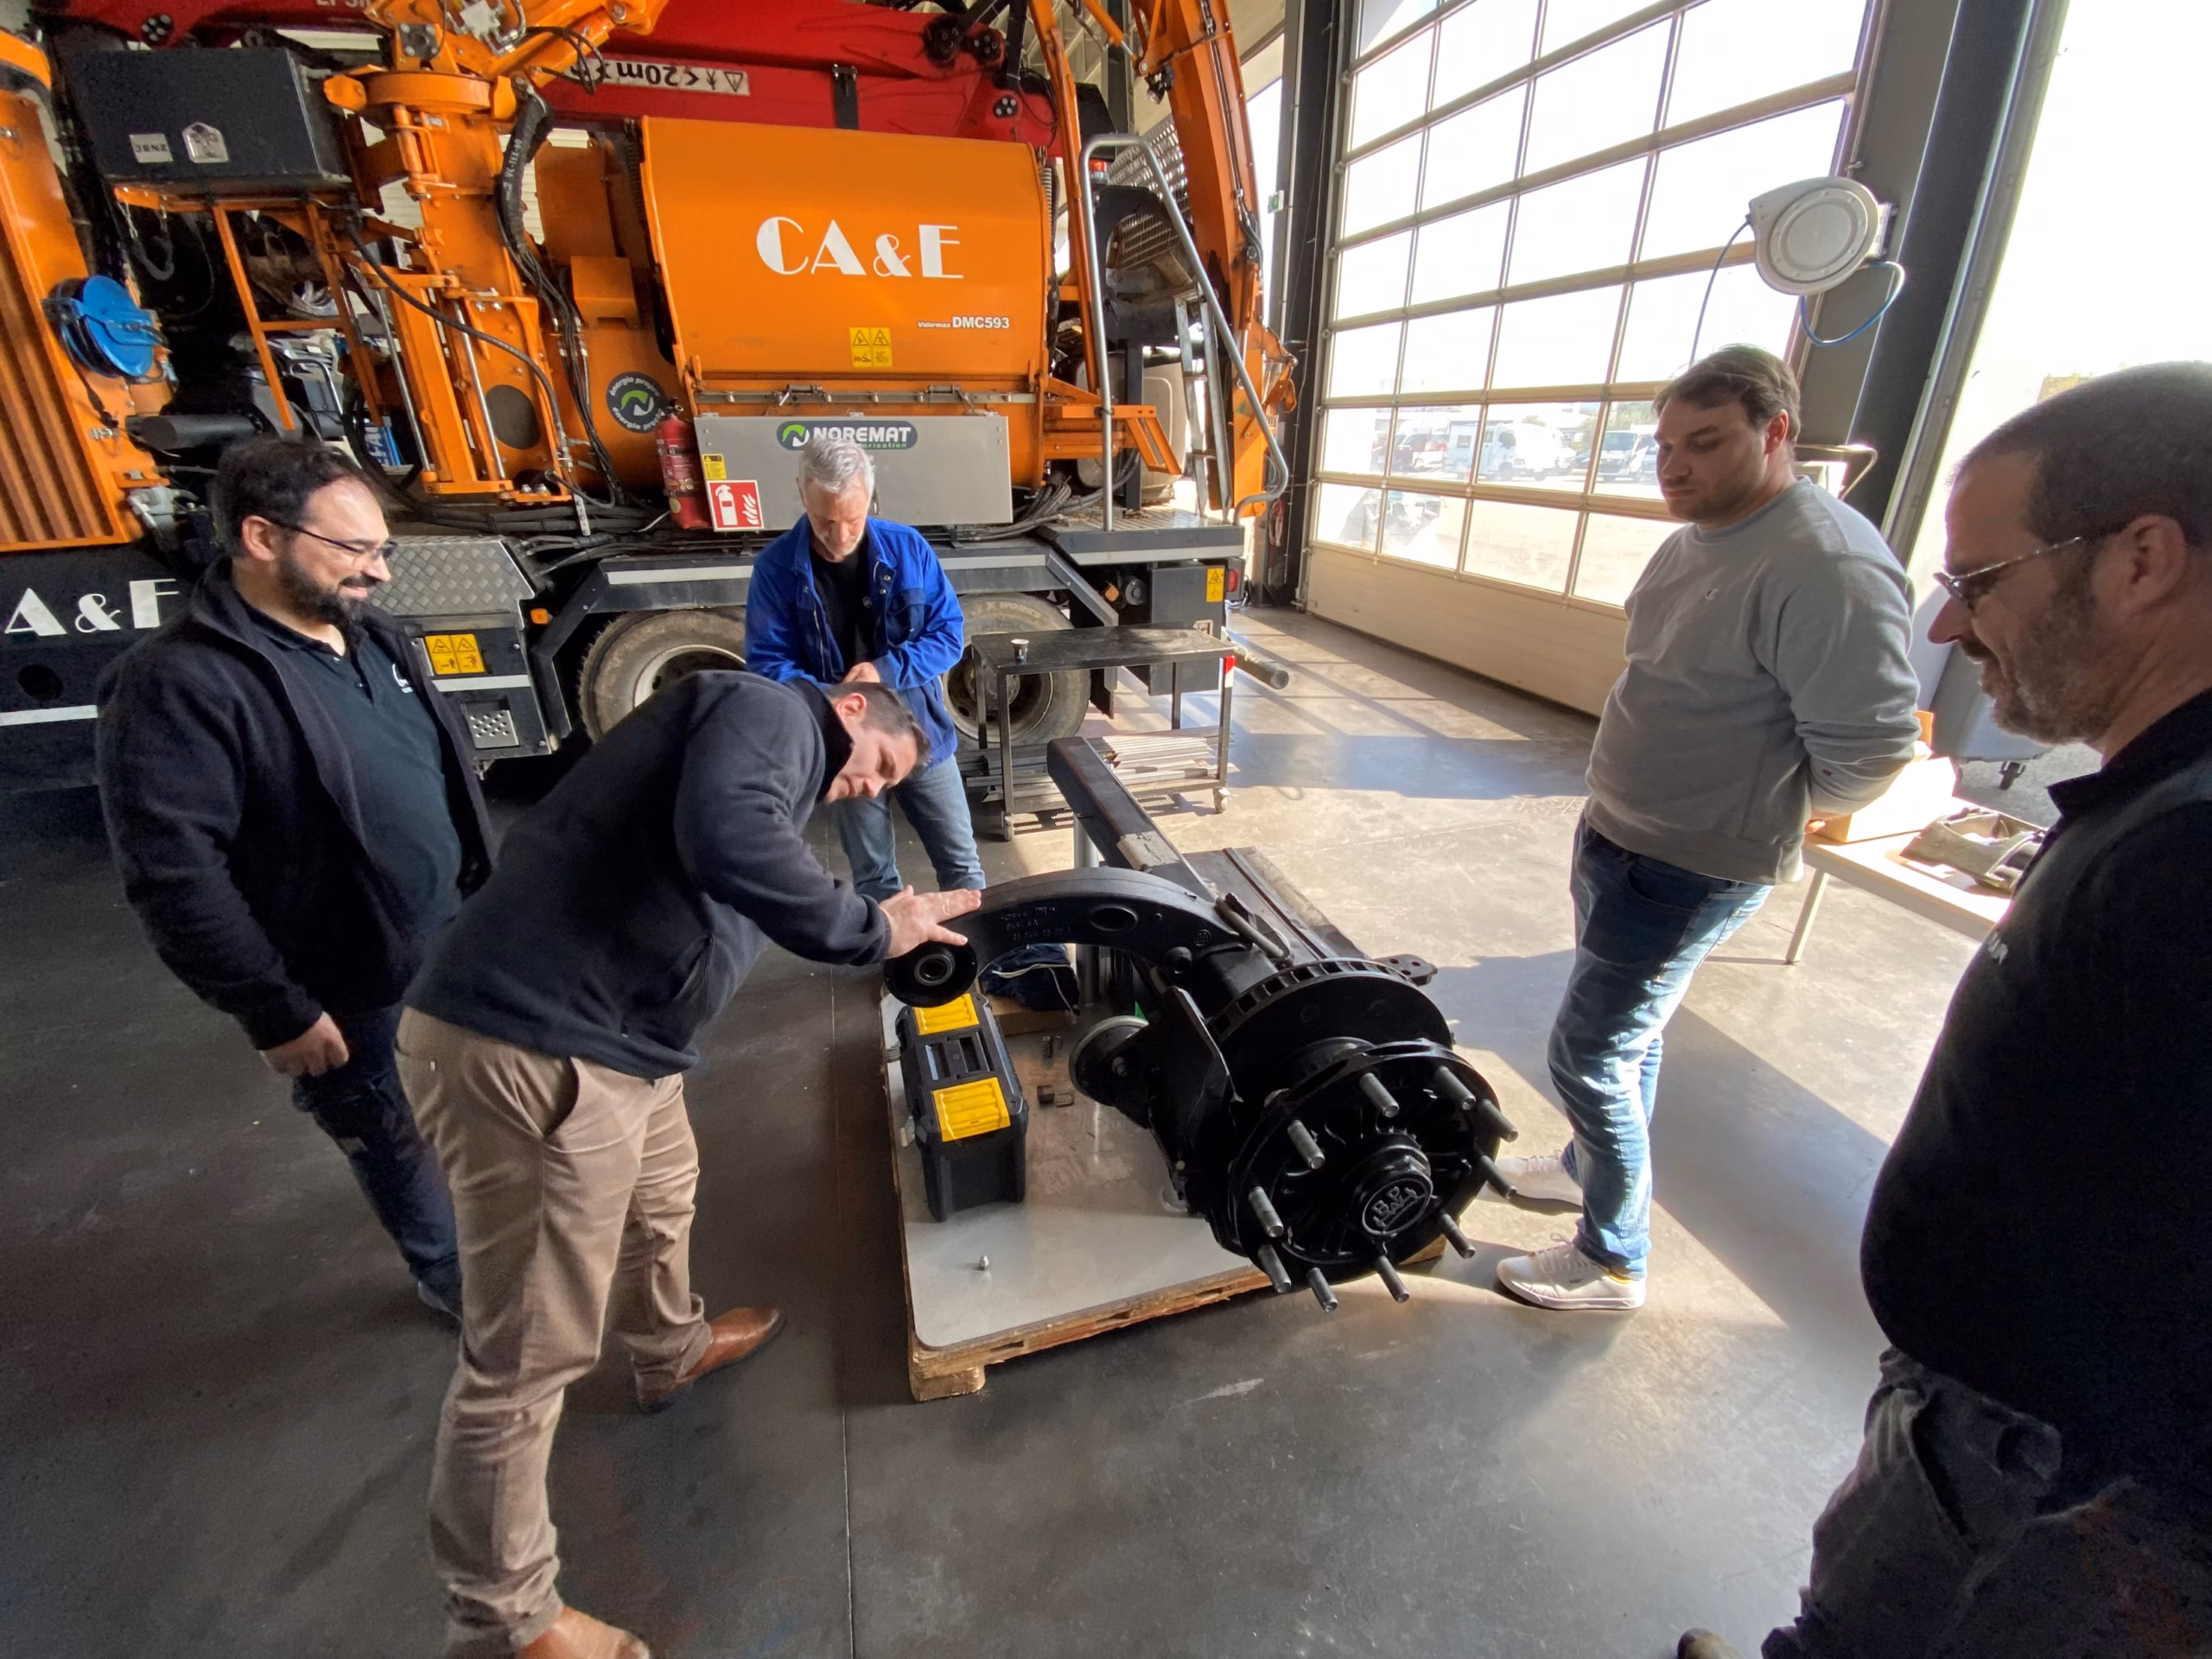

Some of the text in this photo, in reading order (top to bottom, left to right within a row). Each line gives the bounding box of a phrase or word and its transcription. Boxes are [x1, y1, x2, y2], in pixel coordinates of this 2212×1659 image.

[136, 144, 168, 153] JENZ
[952, 315, 1010, 329] DMC593
[635, 378, 660, 397] propre
[813, 427, 912, 442] NOREMAT
